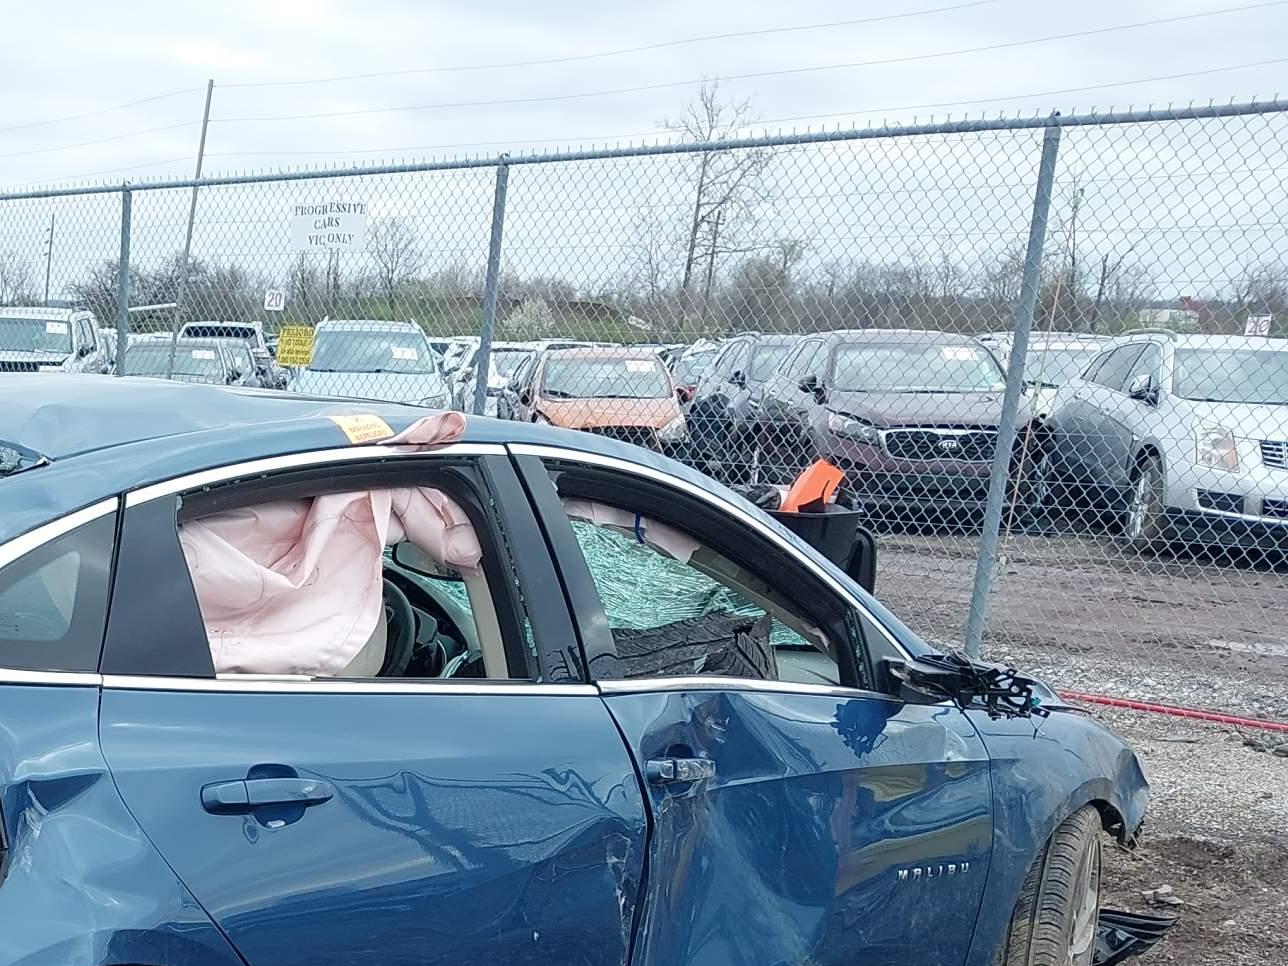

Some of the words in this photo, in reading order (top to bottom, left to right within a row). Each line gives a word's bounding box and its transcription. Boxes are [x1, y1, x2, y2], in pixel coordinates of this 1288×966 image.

[294, 201, 367, 216] PROGRESSIVE
[313, 216, 341, 230] CARS
[308, 234, 326, 246] VIC
[327, 232, 355, 245] ONLY
[267, 292, 282, 307] 20
[897, 862, 970, 881] MALIBU
